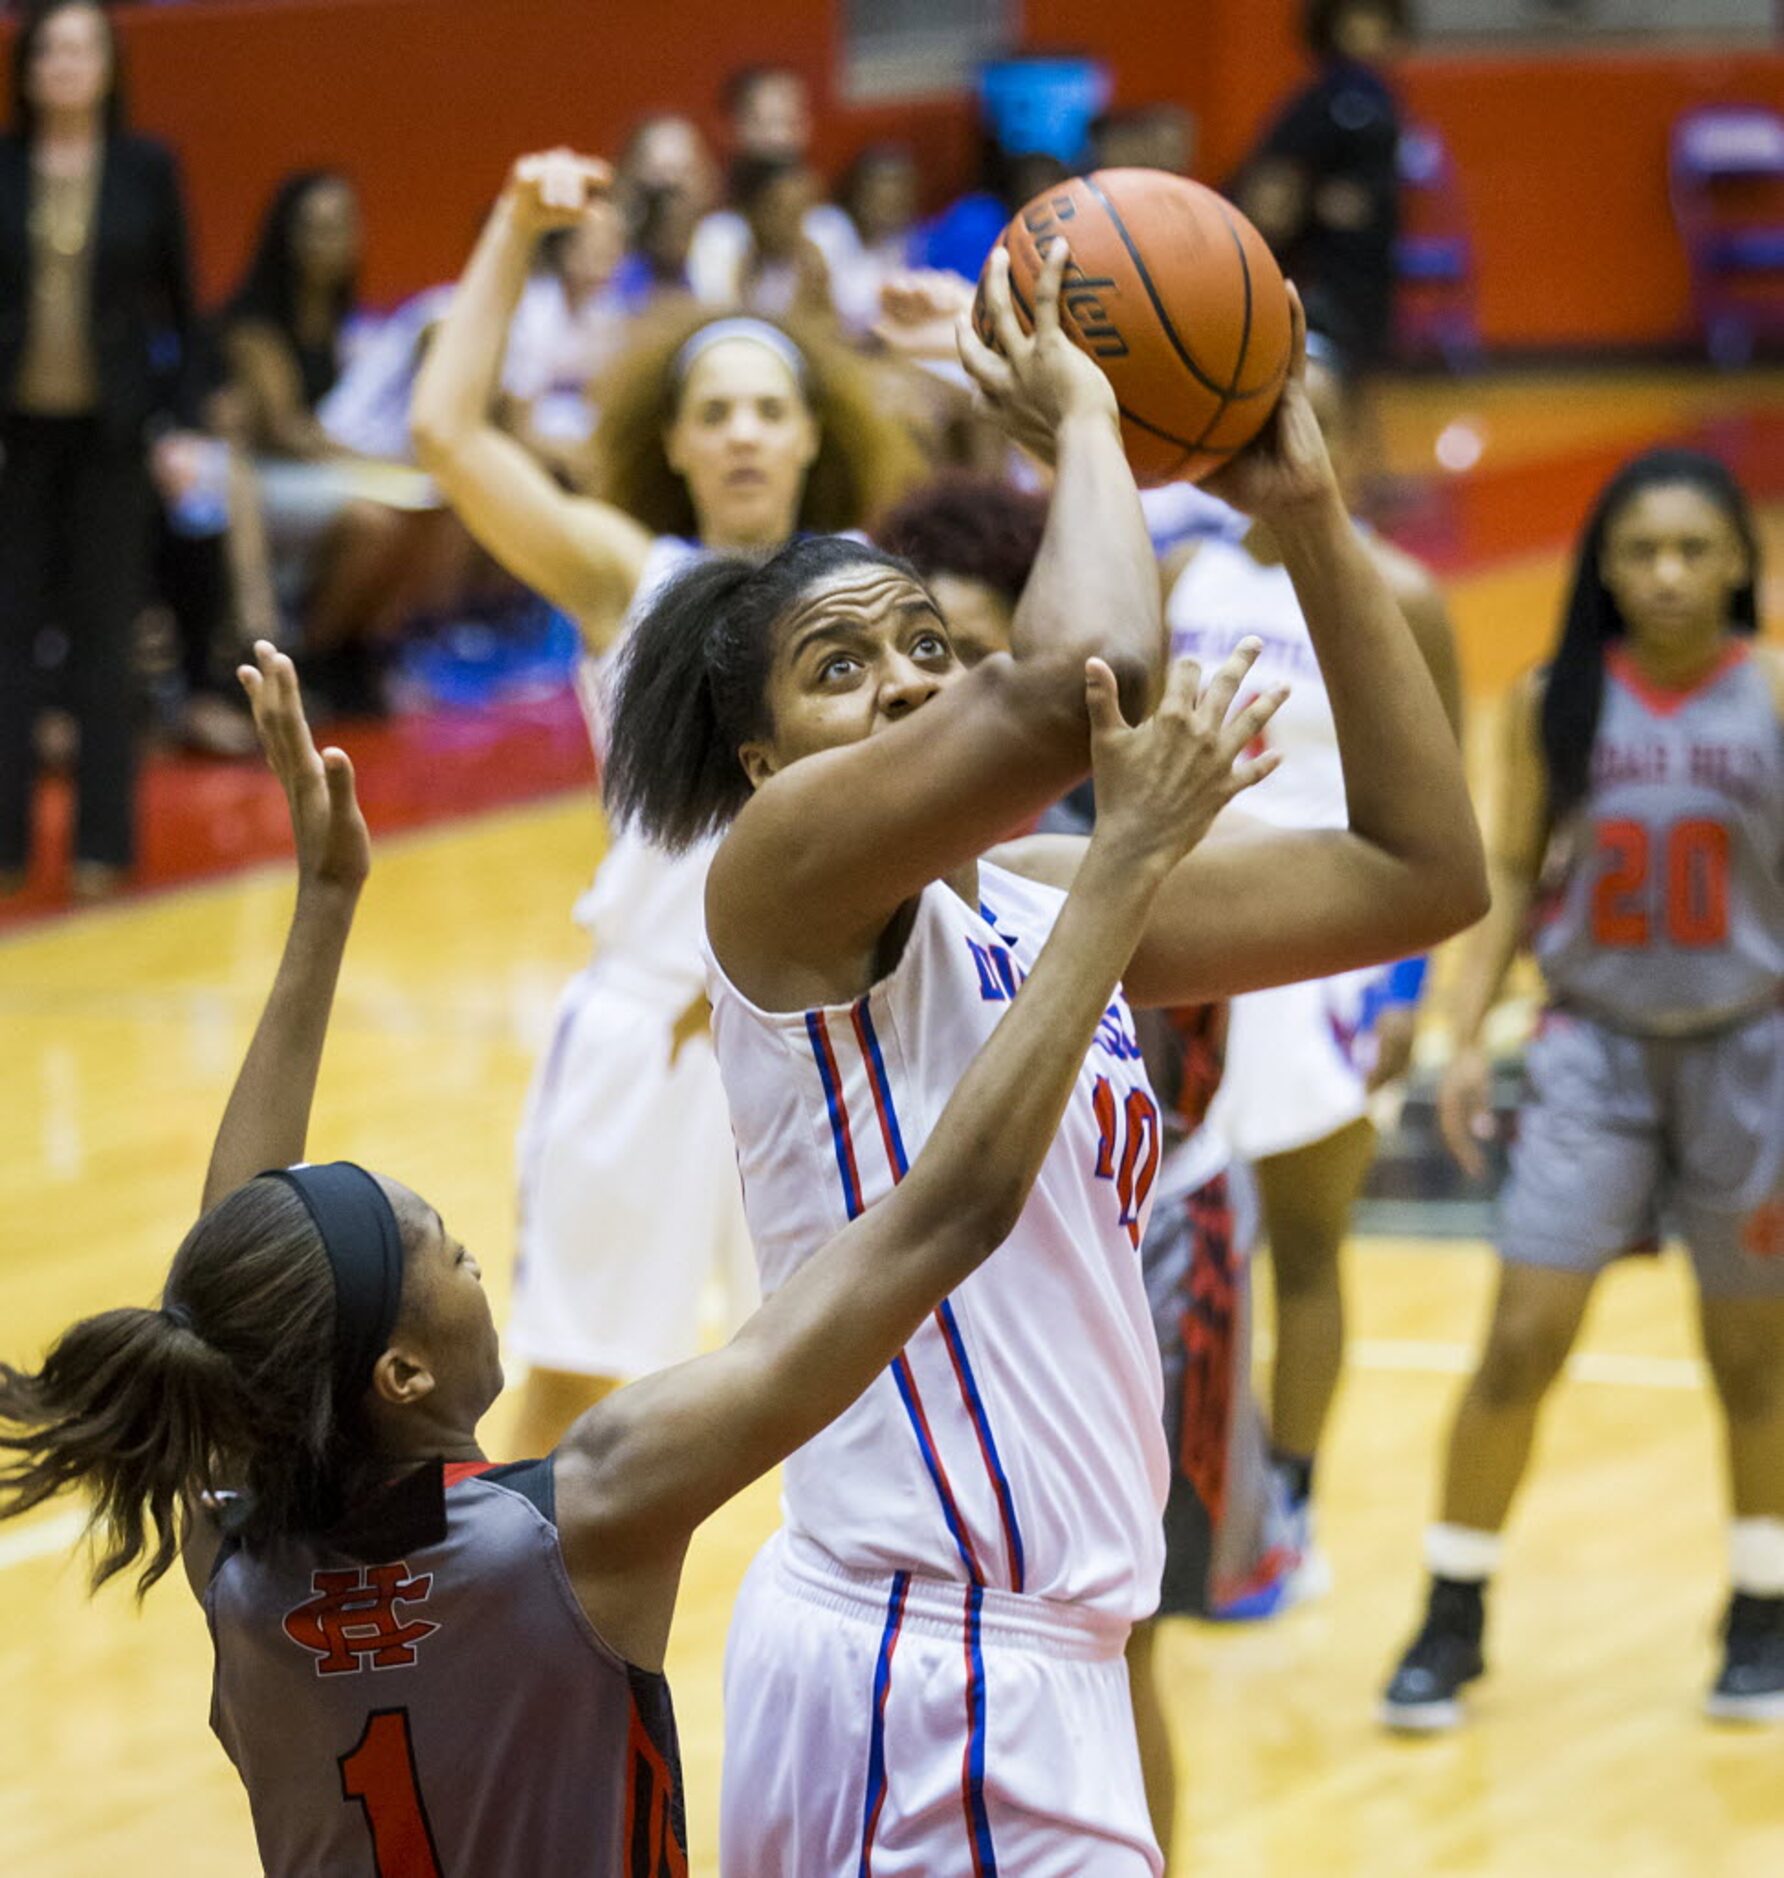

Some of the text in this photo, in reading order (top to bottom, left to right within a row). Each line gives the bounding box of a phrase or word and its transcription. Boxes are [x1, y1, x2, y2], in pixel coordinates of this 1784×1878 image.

[1589, 815, 1730, 948] 20
[1091, 1073, 1159, 1252] 10
[336, 1705, 447, 1878] 1
